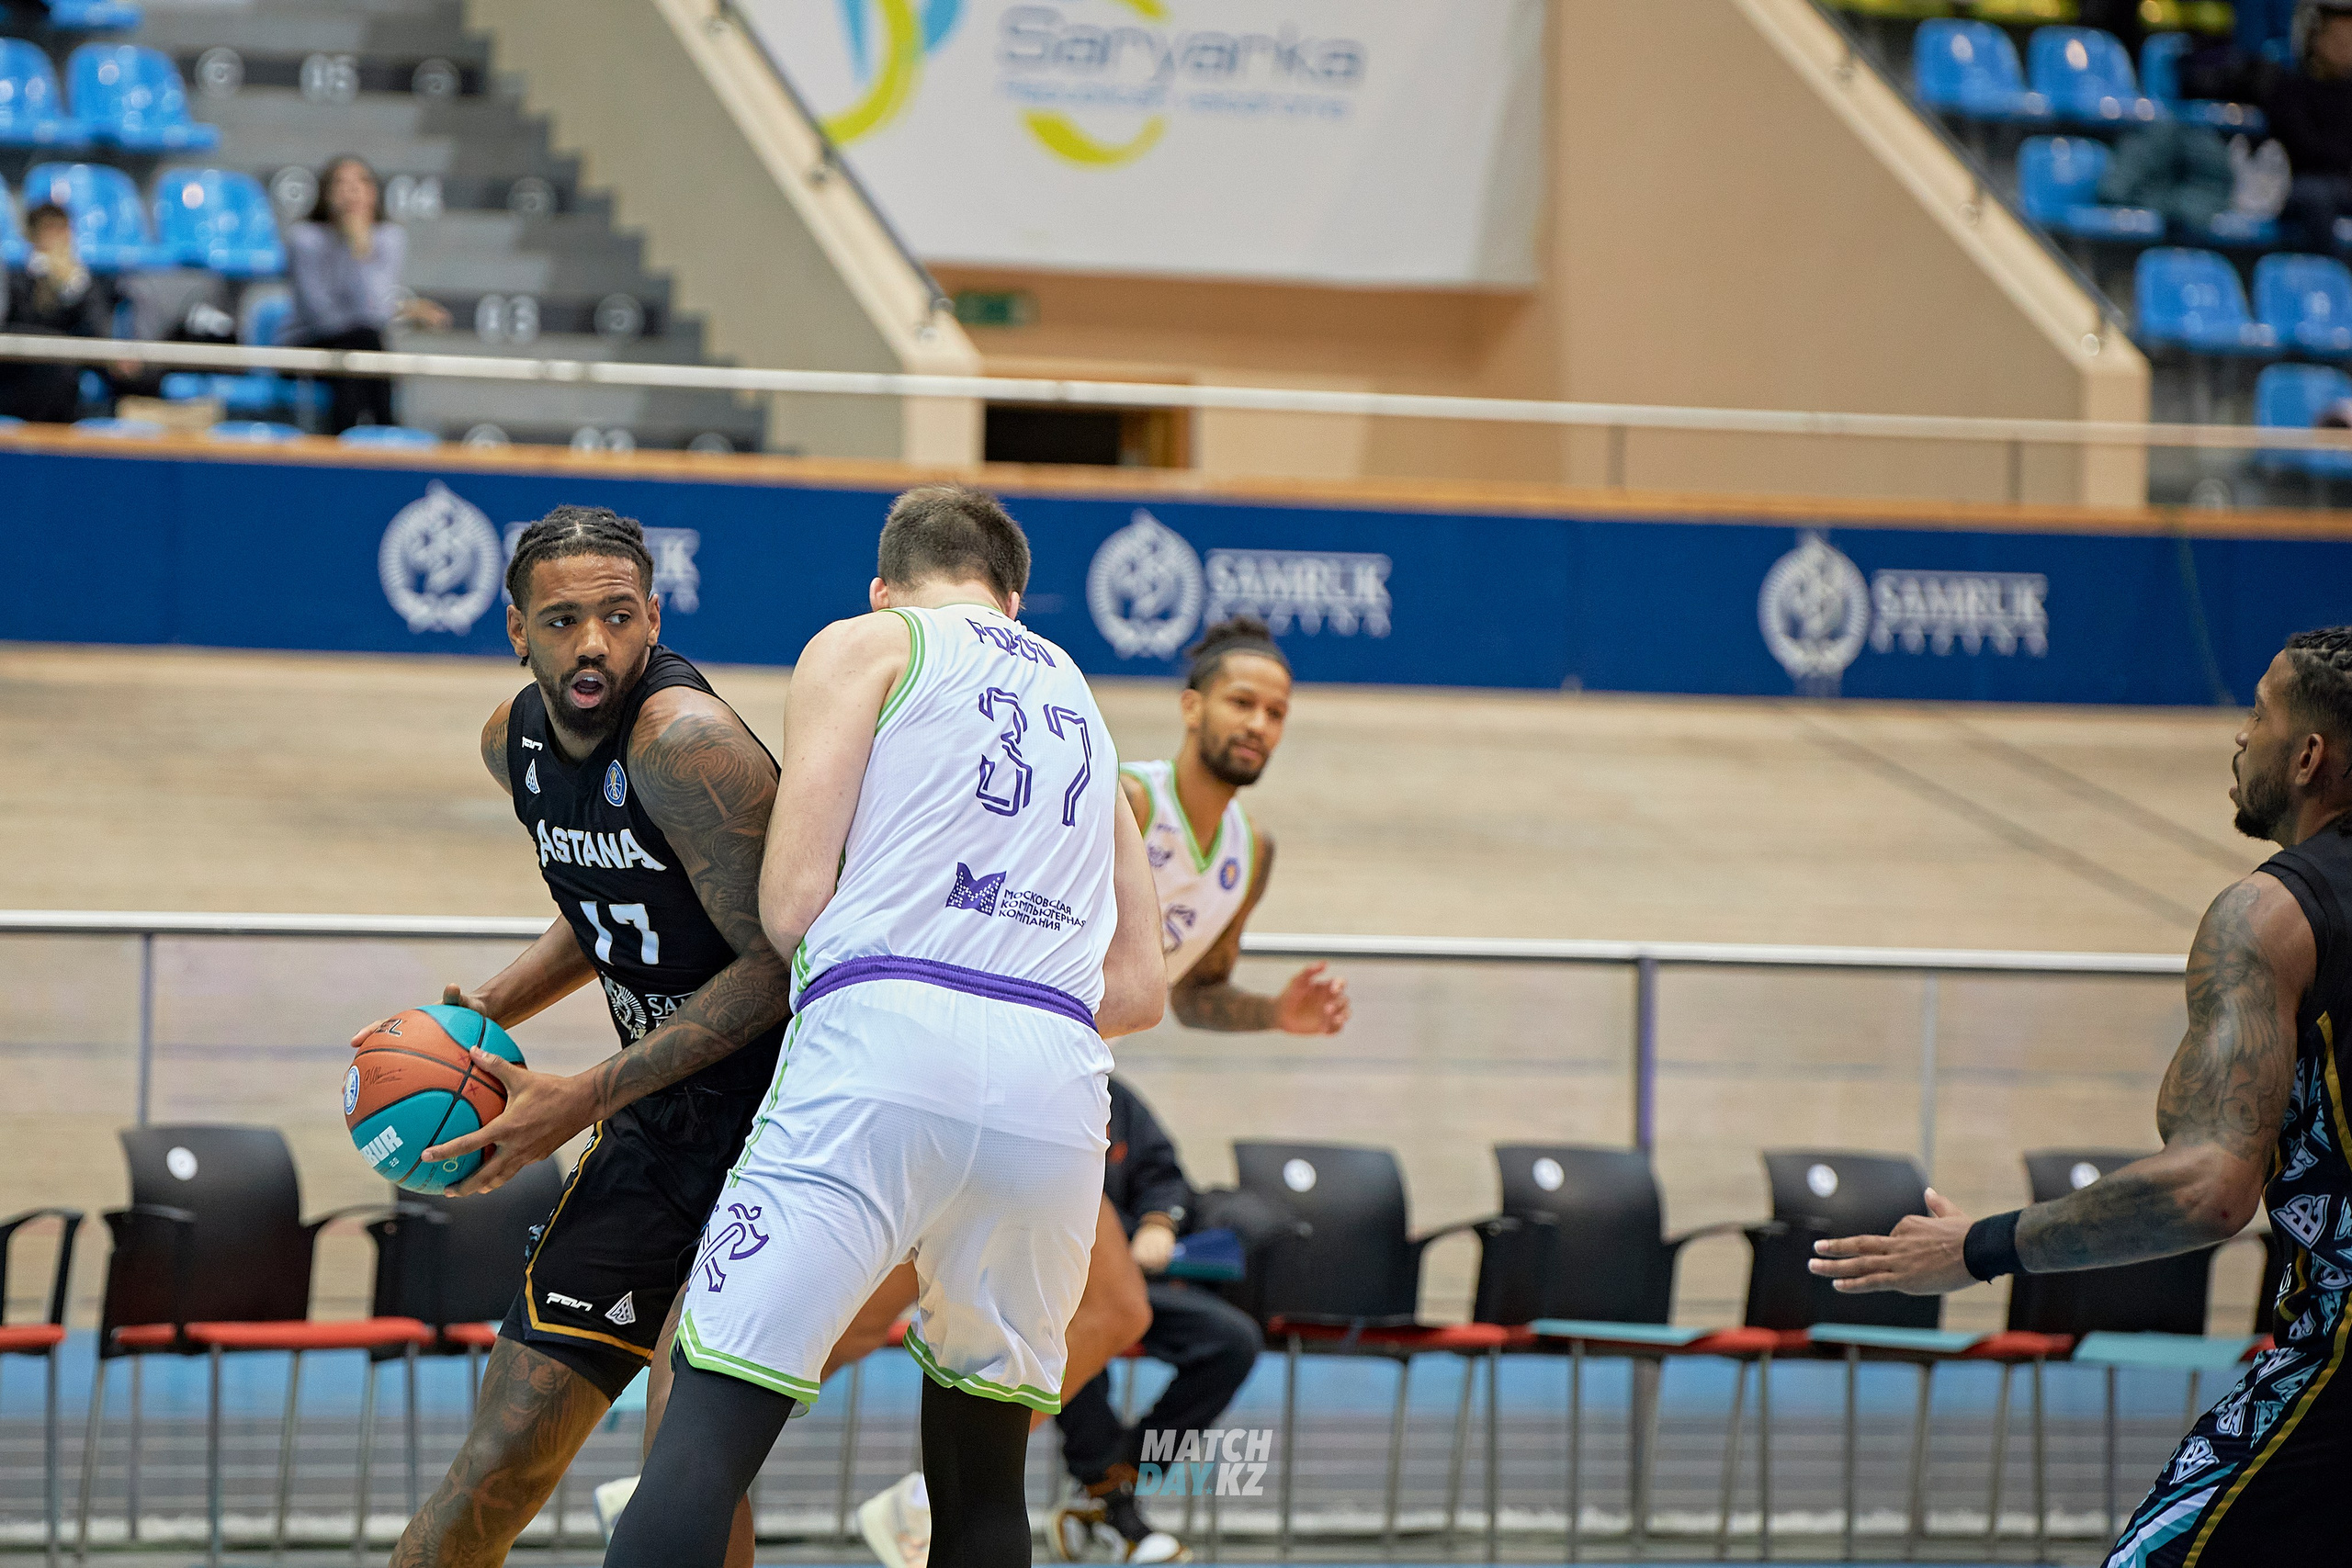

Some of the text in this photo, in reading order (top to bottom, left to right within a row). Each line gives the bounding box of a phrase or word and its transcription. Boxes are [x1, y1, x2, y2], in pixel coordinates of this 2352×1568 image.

[976, 687, 1091, 828] 37
[537, 818, 668, 872] ASTANA
[579, 900, 660, 965] 17
[999, 908, 1060, 931] КОМПАНИЯ
